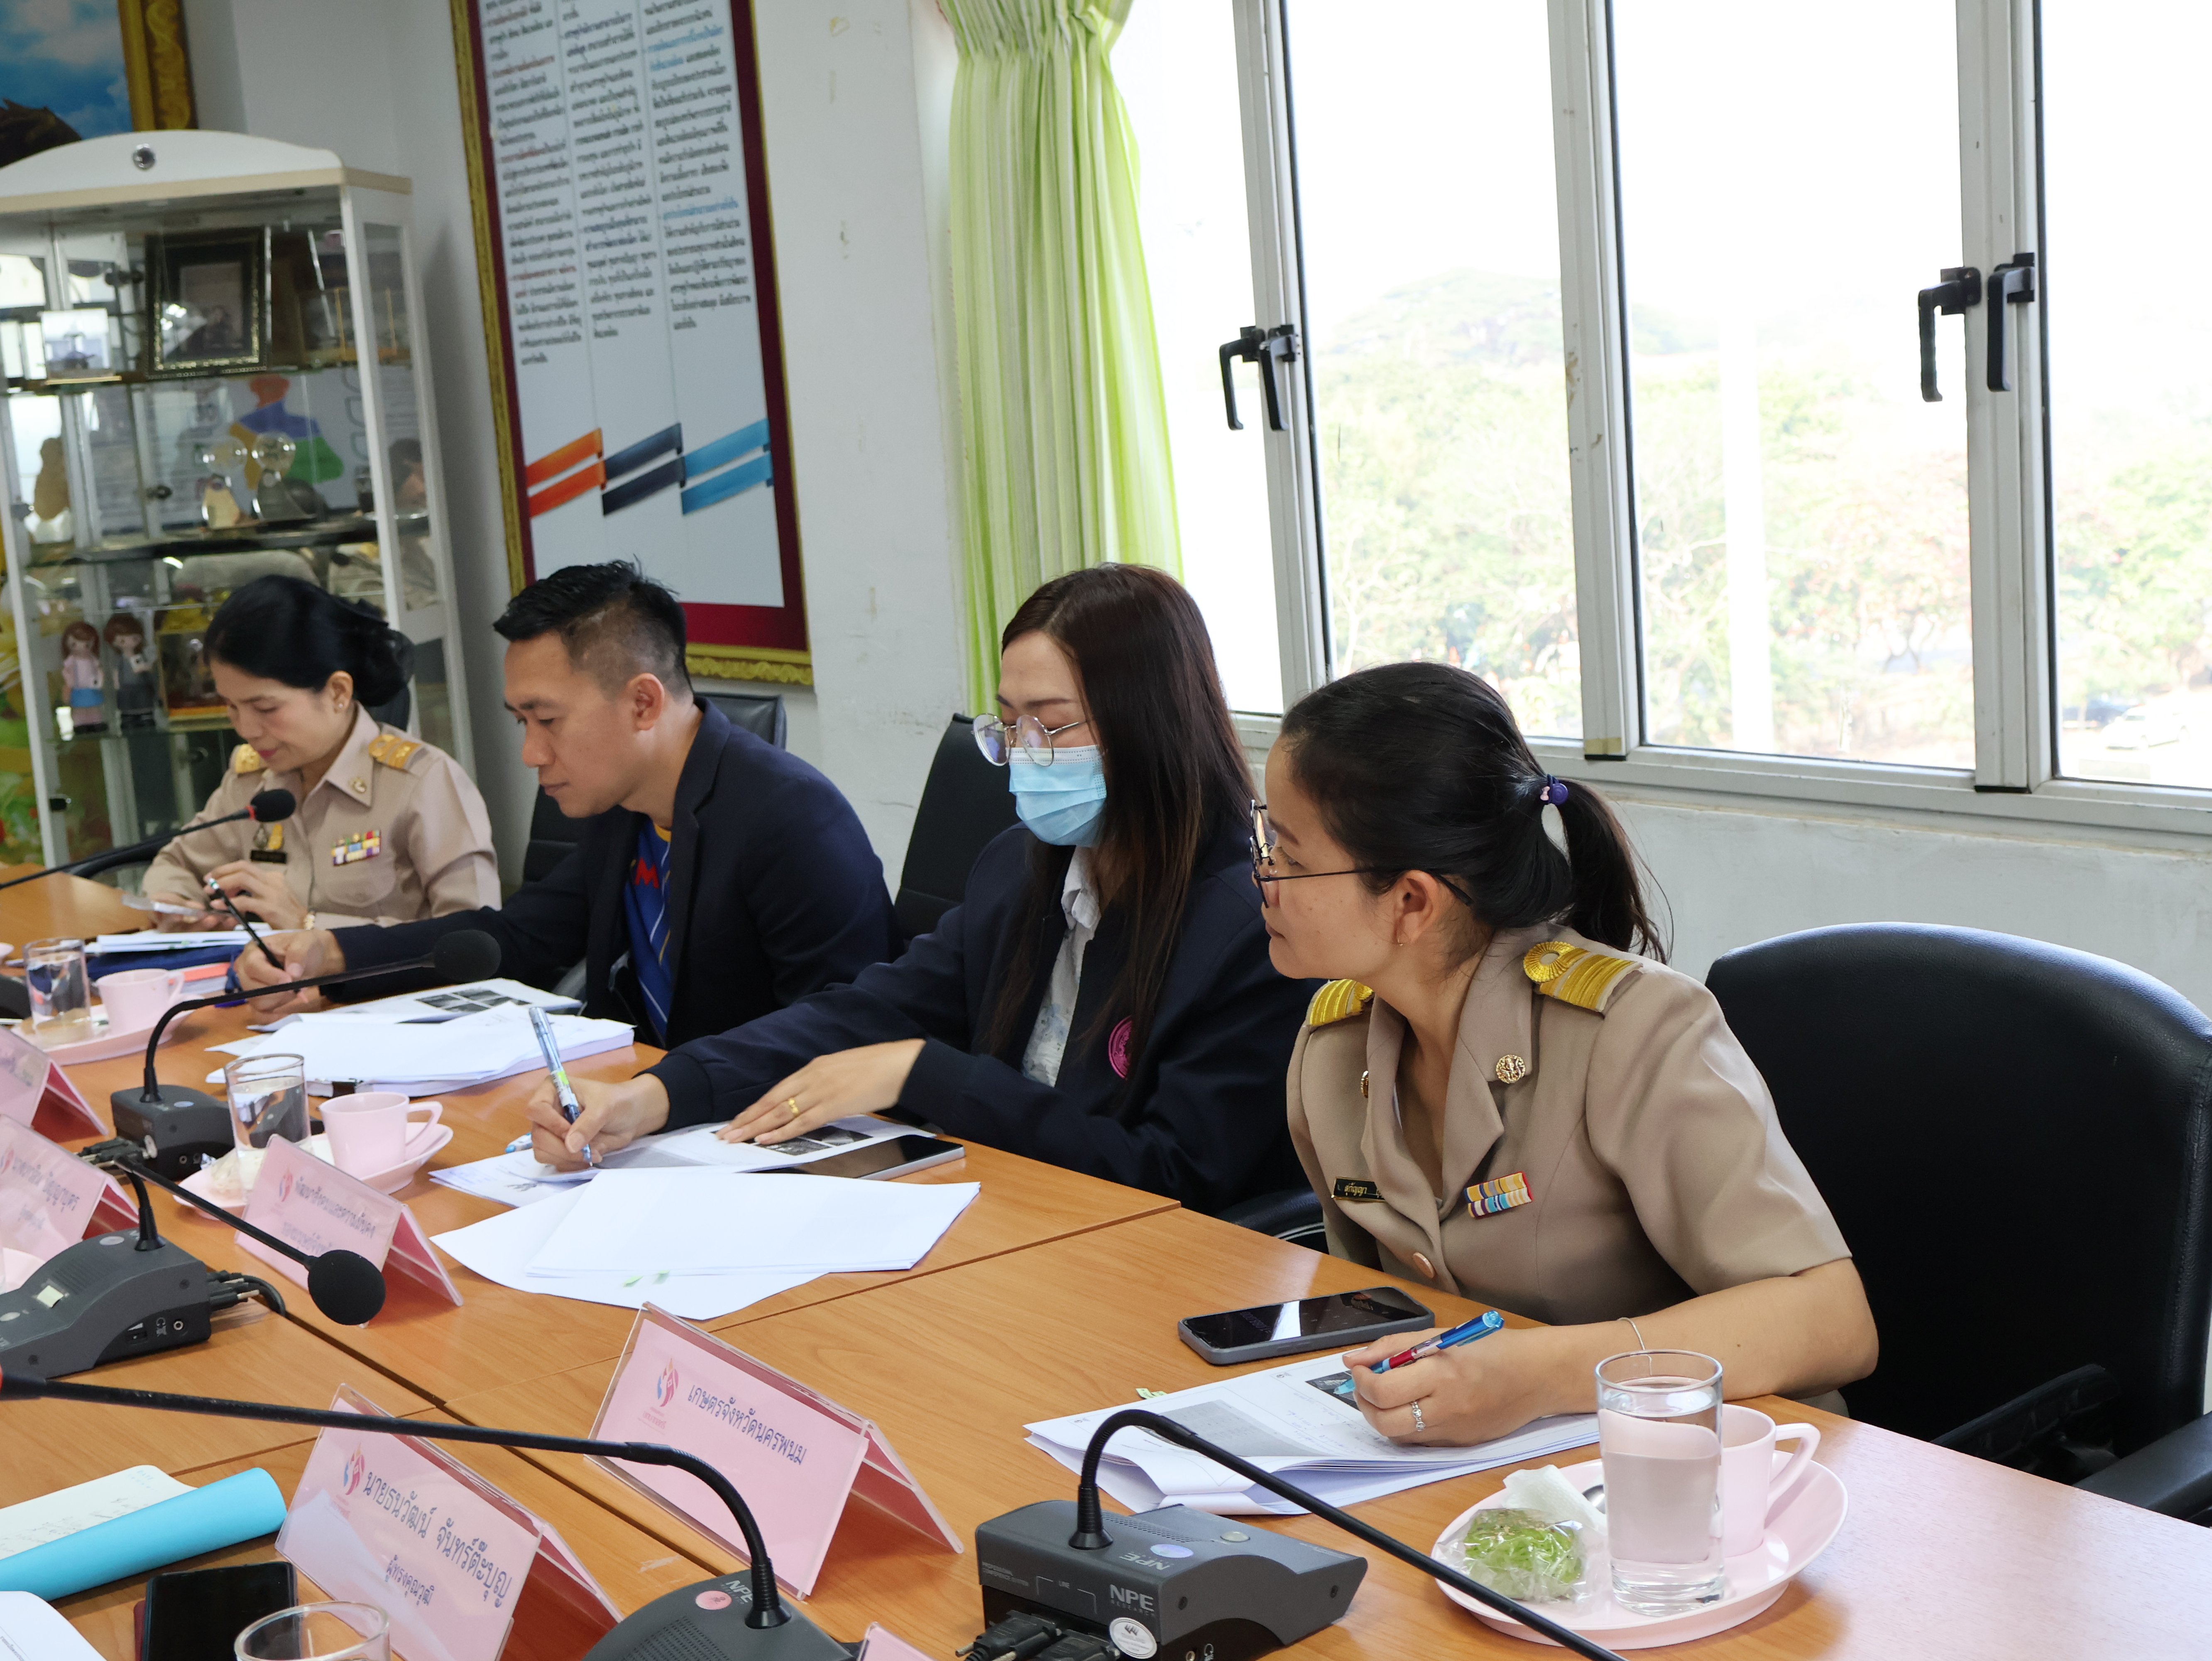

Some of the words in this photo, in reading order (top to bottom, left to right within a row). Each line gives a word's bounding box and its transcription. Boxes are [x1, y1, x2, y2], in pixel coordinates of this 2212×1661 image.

[688, 1384, 807, 1465] เกษตรจังหวัดนครพนม
[363, 1472, 438, 1539] นายธนวัฒน์
[384, 1554, 435, 1606] ผู้ทรงคุณวุฒิ
[1119, 1553, 1170, 1570] NPE
[1110, 1584, 1155, 1612] NPE
